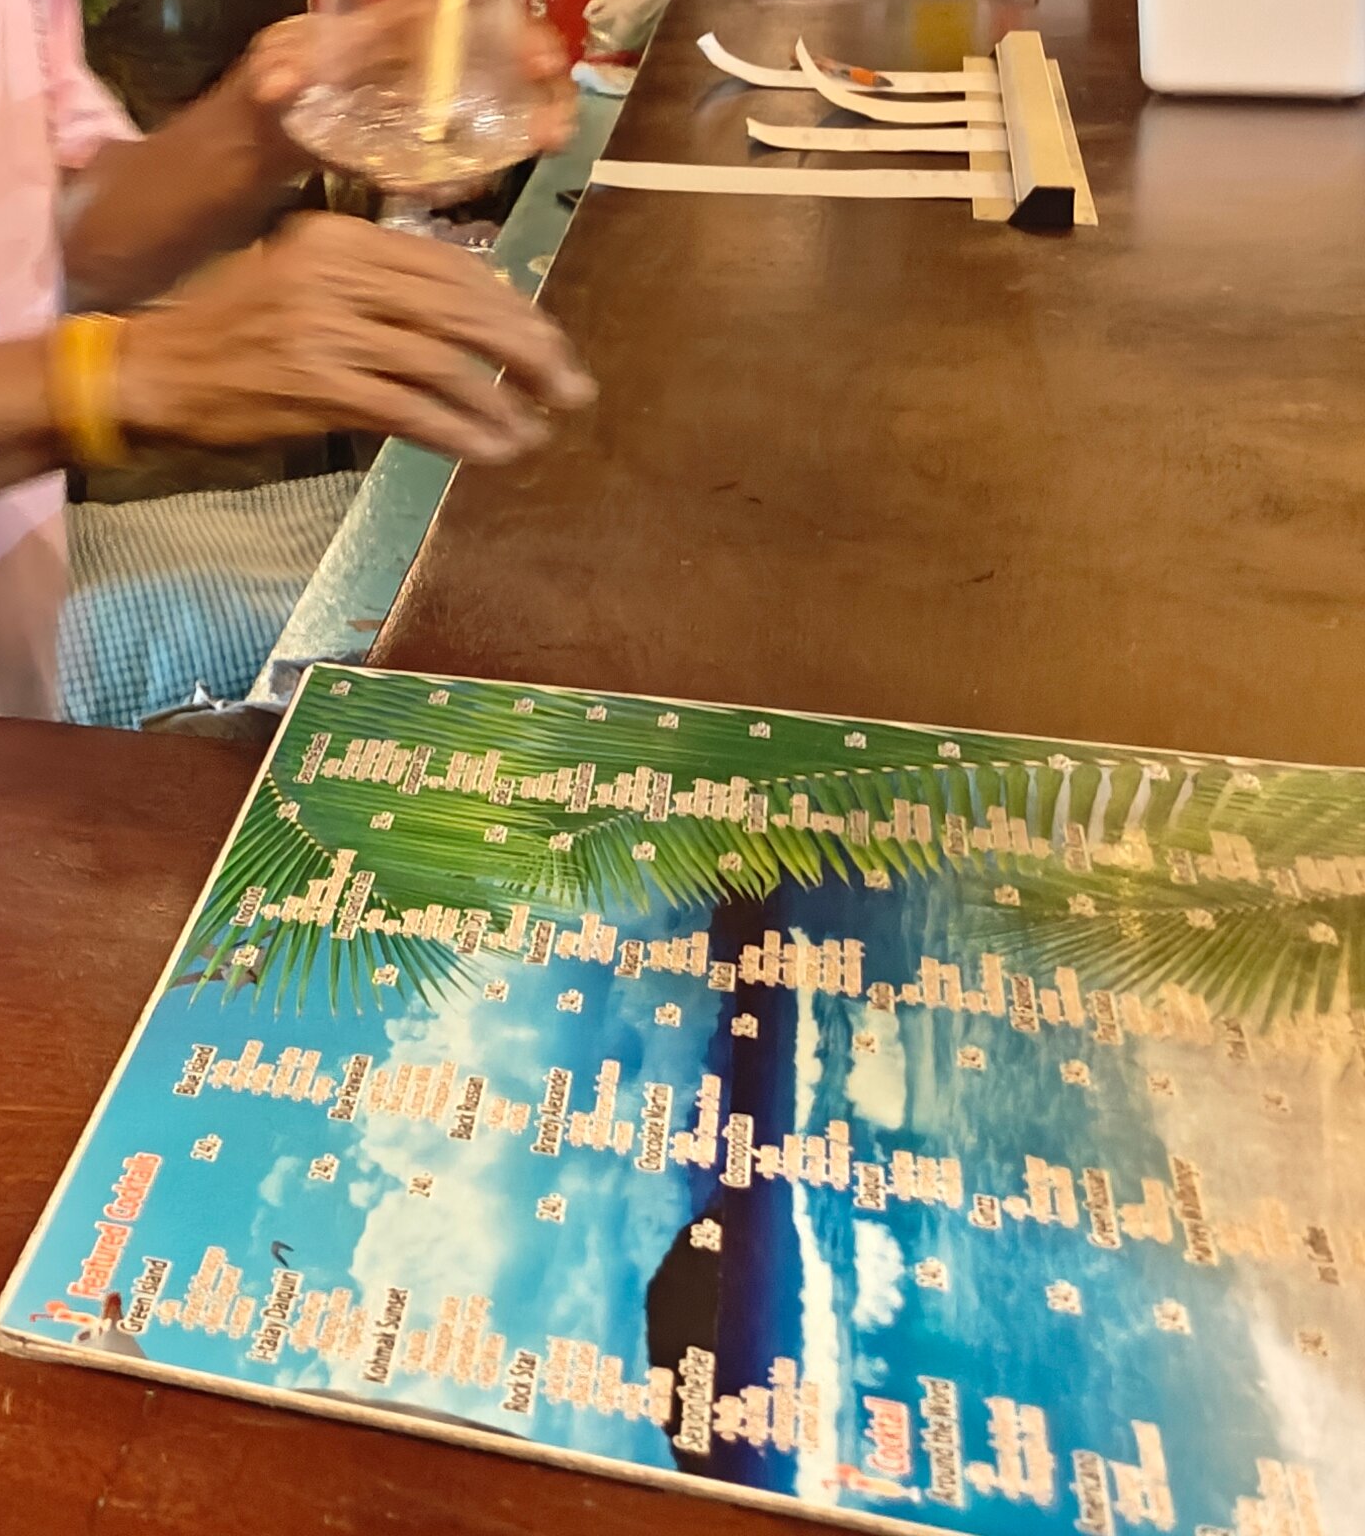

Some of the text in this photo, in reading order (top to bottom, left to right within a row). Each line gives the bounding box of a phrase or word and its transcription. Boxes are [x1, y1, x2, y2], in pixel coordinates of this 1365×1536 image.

[174, 1045, 214, 1095] Blue Island
[451, 1075, 484, 1139] Black Russian
[330, 1097, 355, 1120] Blue
[534, 1066, 570, 1155] Brandy Alexander
[636, 1082, 668, 1171] Chocolate Martini
[726, 1112, 751, 1187] Cosmopolitan
[68, 1151, 162, 1297] Featured Cocktails
[120, 1258, 170, 1333] Green Island
[252, 1270, 302, 1361] i-talay Daiquiri
[365, 1285, 408, 1383] Kohmak Sunset
[506, 1348, 537, 1410] Rock Star
[678, 1416, 708, 1447] Sex
[866, 1397, 910, 1476] Cocktail
[924, 1416, 956, 1444] the
[926, 1441, 965, 1505] Around
